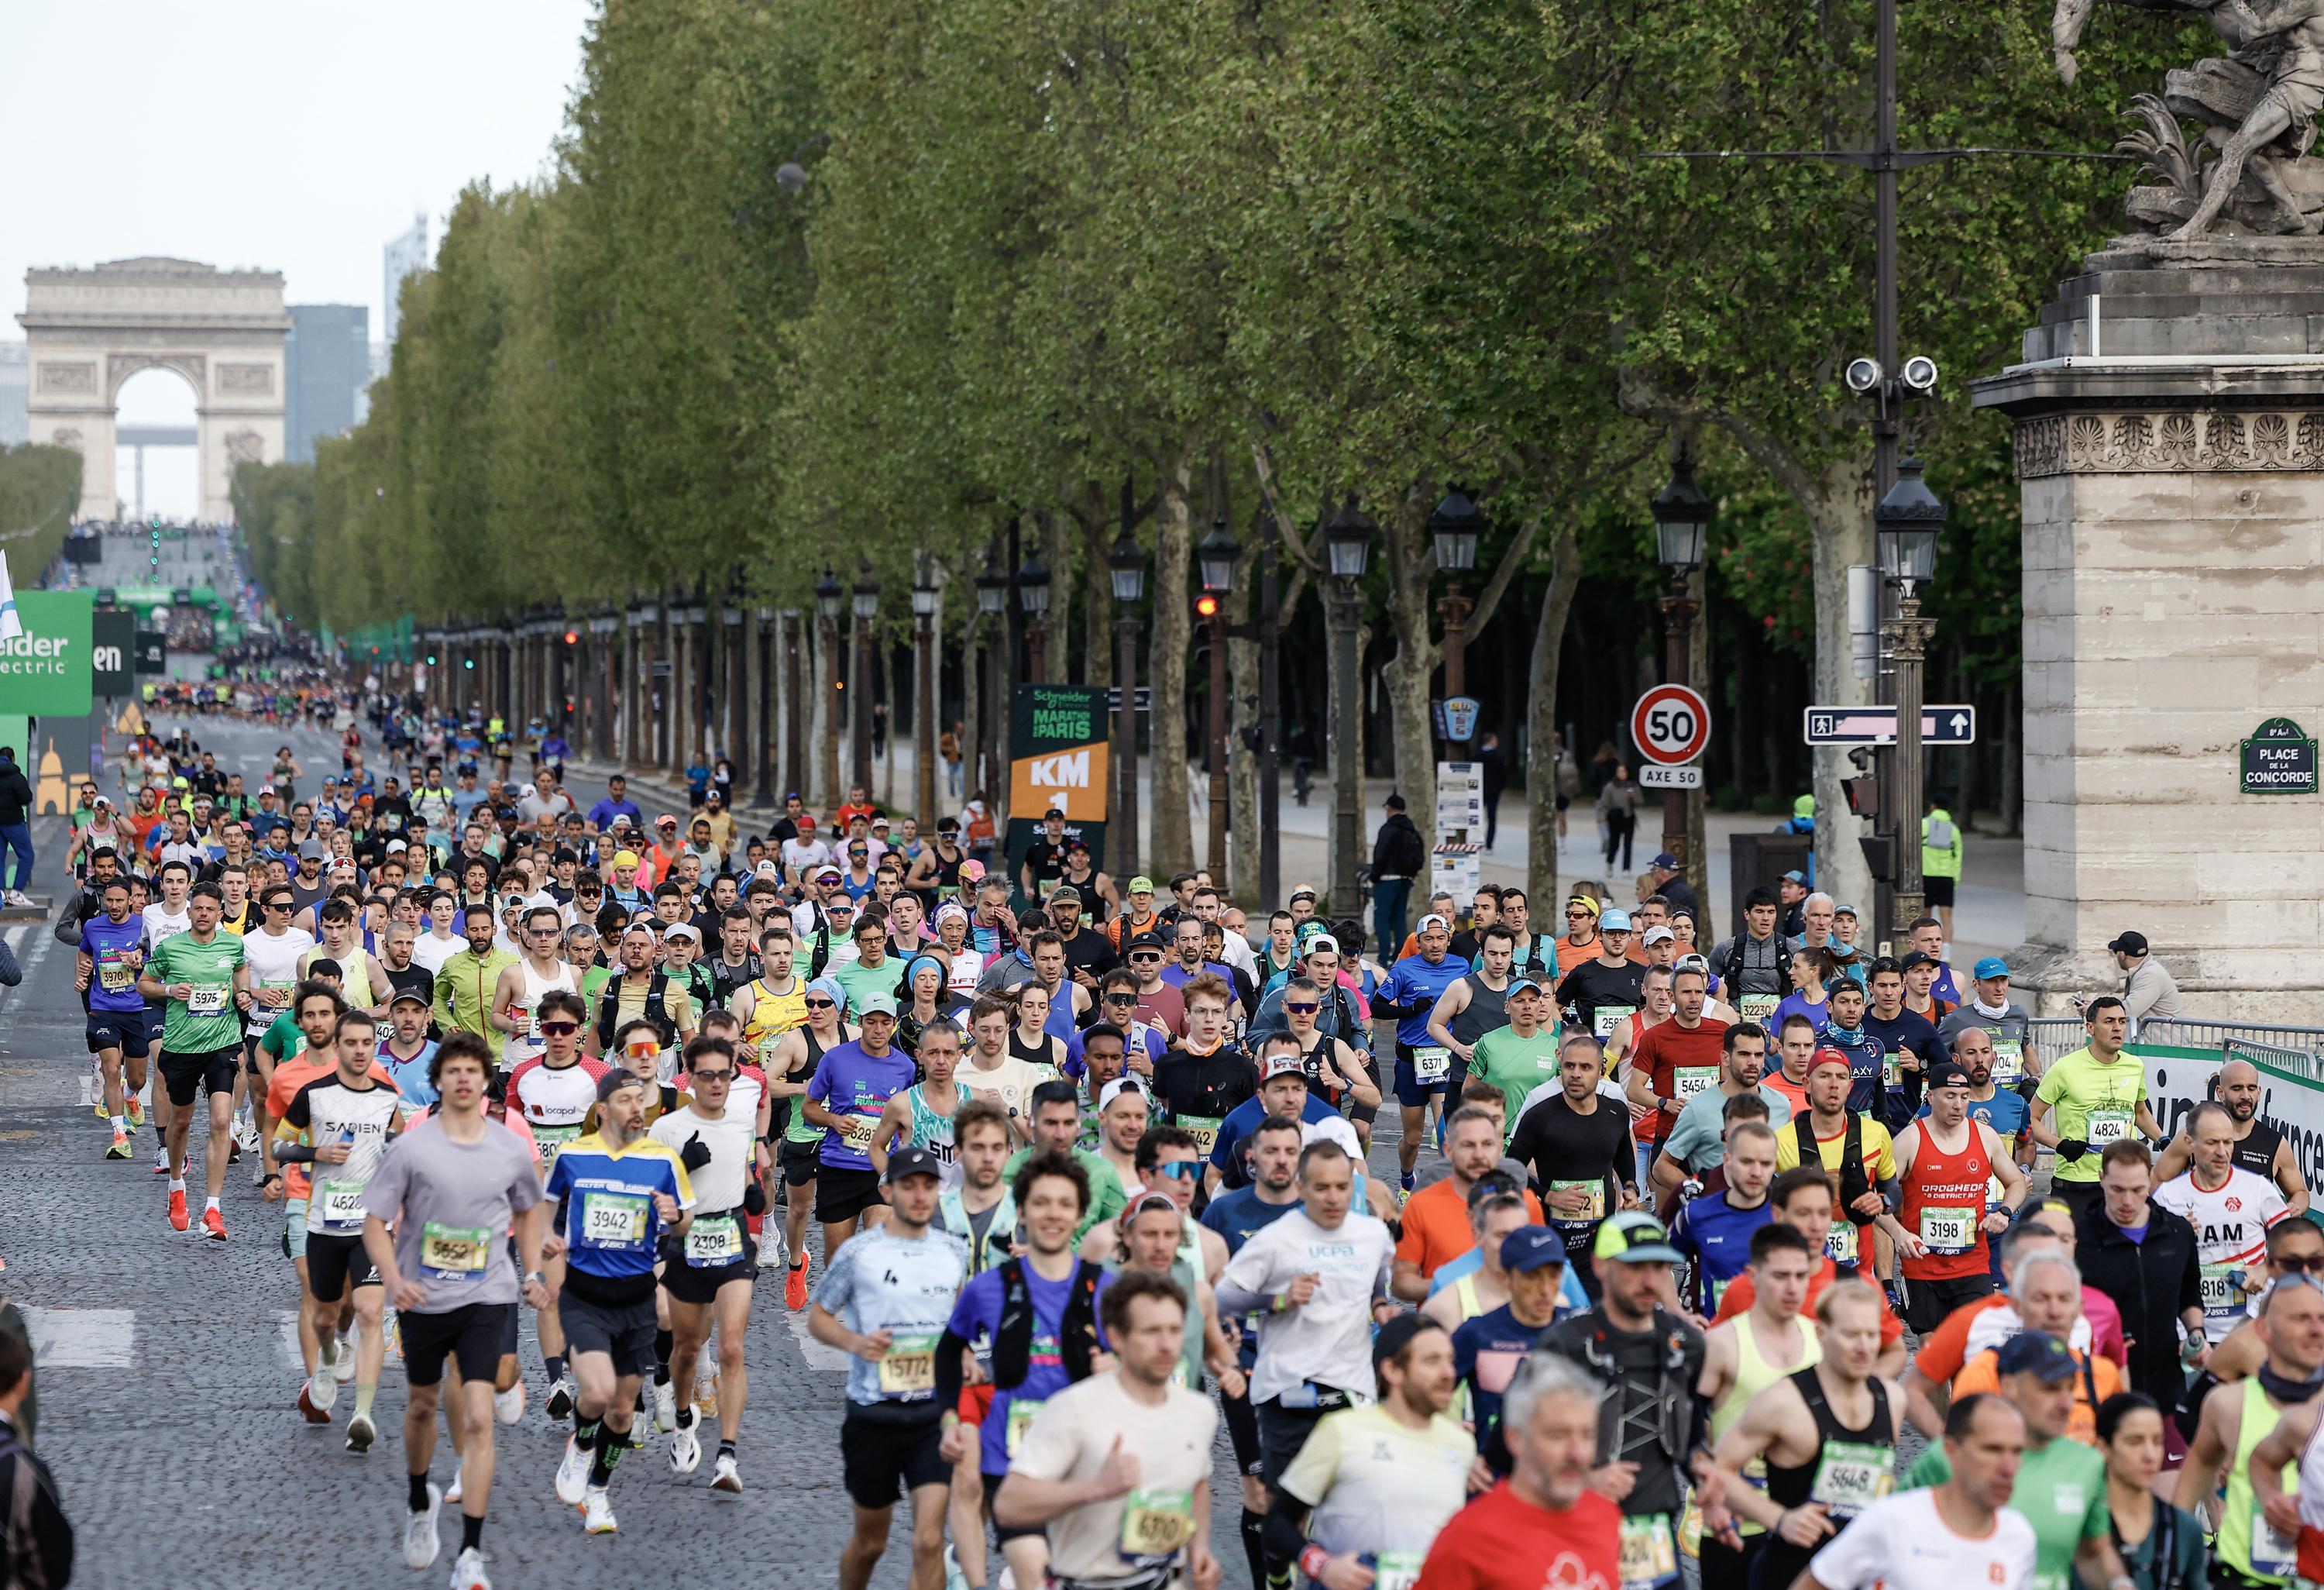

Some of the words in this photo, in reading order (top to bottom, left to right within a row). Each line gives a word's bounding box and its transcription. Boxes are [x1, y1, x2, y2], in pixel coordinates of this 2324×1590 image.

[0, 629, 68, 657] ider
[1033, 690, 1092, 703] Schneider
[1033, 710, 1092, 724] MARATHON
[1040, 721, 1092, 740] PARIS
[1649, 711, 1693, 742] 50
[2259, 749, 2299, 760] PLACE
[1030, 750, 1091, 788] KM
[1645, 771, 1672, 783] AXE
[1679, 773, 1697, 783] 50
[2246, 771, 2313, 783] CONCORDE
[1049, 791, 1069, 816] 1
[1032, 824, 1083, 837] Scider
[103, 971, 124, 983] 3970
[195, 993, 218, 1004] 5975
[1743, 1005, 1772, 1017] 32230
[1602, 1017, 1623, 1030] 258
[376, 1026, 395, 1038] 402
[1422, 1058, 1442, 1070] 6371
[1850, 1065, 1873, 1075] AXY
[1681, 1079, 1706, 1093] 5454
[545, 1105, 576, 1117] locapal
[1181, 1116, 1212, 1124] Schneider
[850, 1127, 877, 1142] 628
[2095, 1123, 2120, 1136] 4824
[538, 1143, 561, 1158] 80
[929, 1139, 956, 1165] SM
[1921, 1183, 1984, 1192] DROGHEDA
[593, 1211, 627, 1229] 3942
[1930, 1222, 1958, 1237] 3198
[693, 1234, 725, 1249] 2308
[1570, 1233, 1590, 1241] COMP
[2201, 1280, 2226, 1296] 818
